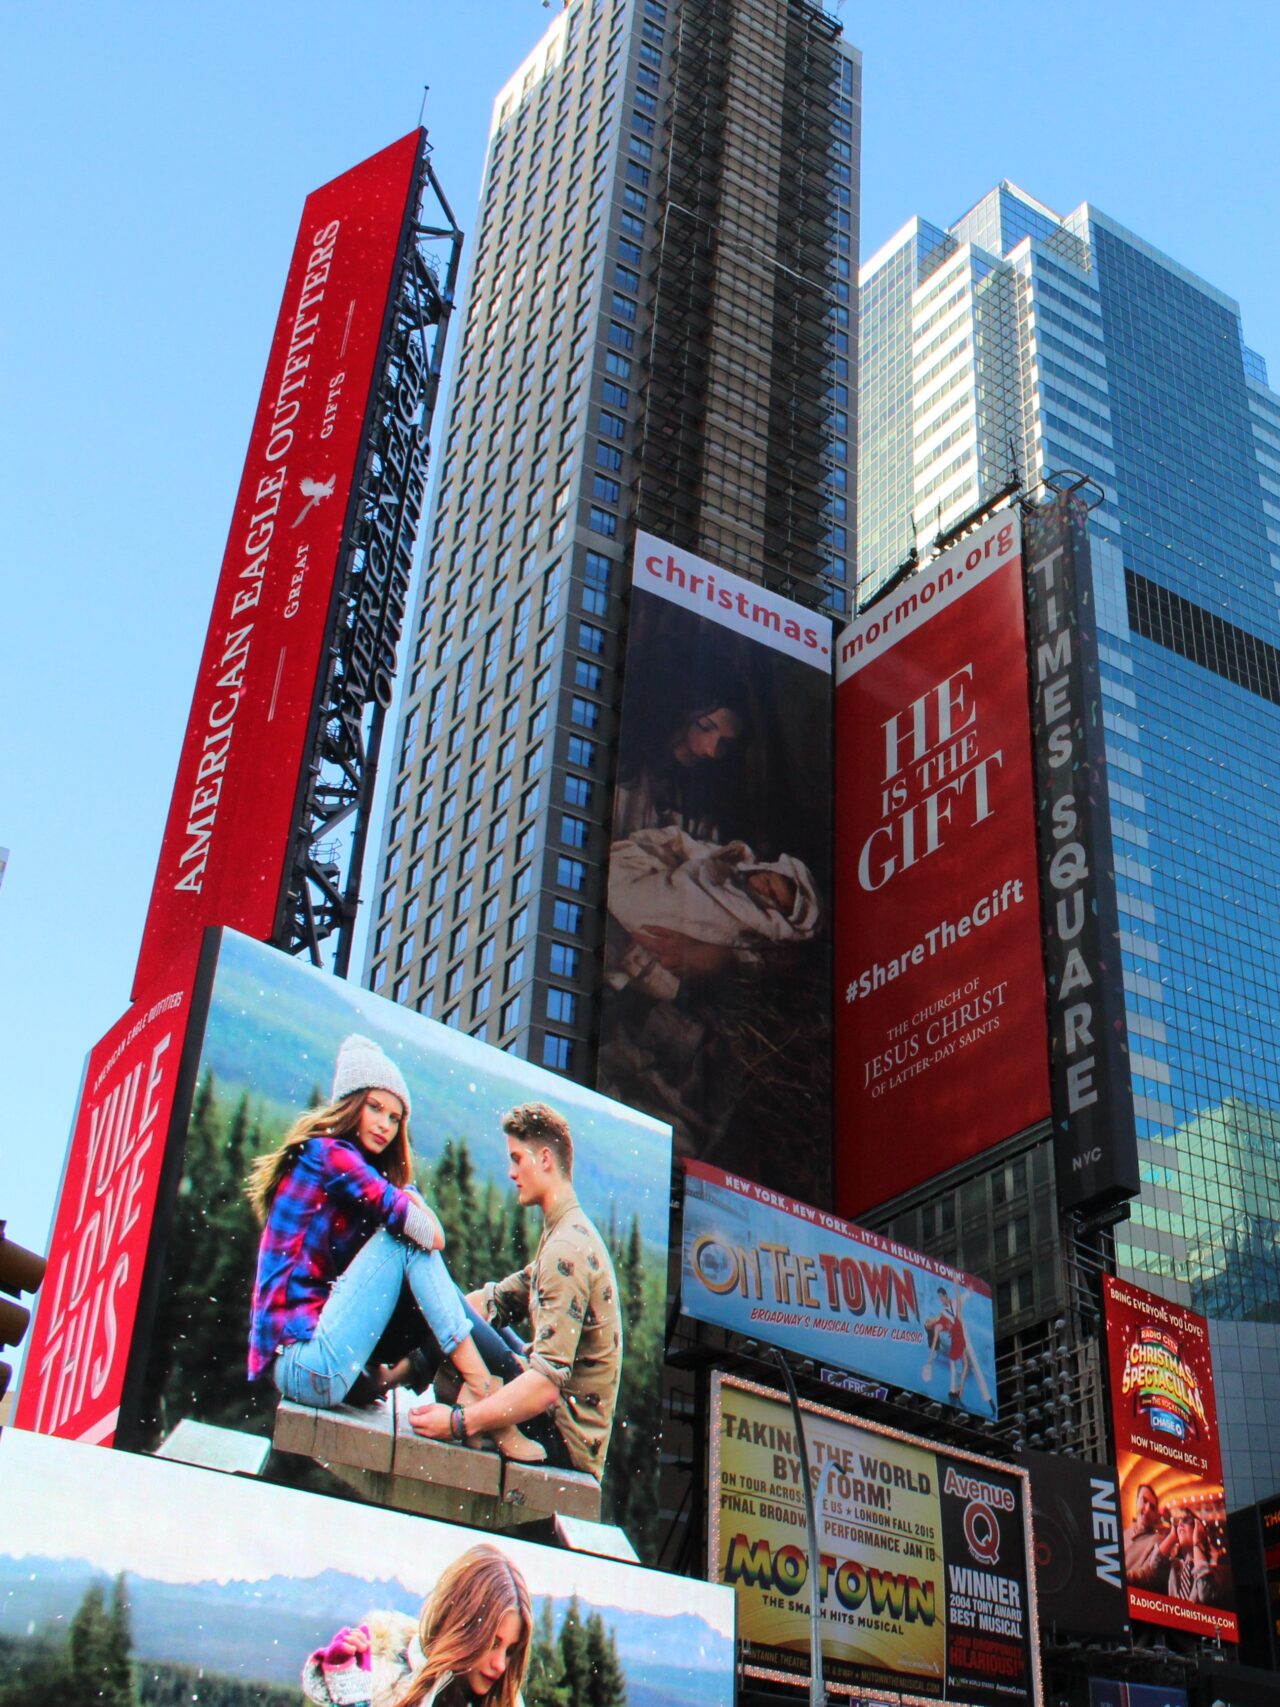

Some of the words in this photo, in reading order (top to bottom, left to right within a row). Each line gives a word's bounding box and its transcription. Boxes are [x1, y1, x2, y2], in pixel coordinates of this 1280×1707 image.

[283, 542, 310, 621] GREAT
[320, 370, 346, 440] GIFTS
[174, 624, 254, 895] AMERICAN
[231, 466, 287, 609] EAGLE
[264, 217, 341, 468] OUTFITTERS
[842, 521, 1014, 664] mormon.org
[645, 552, 829, 655] christmas.
[1031, 545, 1073, 769] TIMES
[881, 662, 976, 785] HE
[881, 778, 908, 819] IS
[916, 729, 979, 792] THE
[858, 749, 1003, 892] GIFT
[846, 878, 1025, 1004] #ShareTheGift
[1049, 794, 1098, 1115] SQUARE
[93, 1037, 128, 1096] AMERICAN
[125, 1016, 147, 1048] EAGLE
[147, 990, 183, 1027] OUTFITTERS
[864, 1033, 920, 1089] JESUS
[926, 981, 1008, 1047] CHRIST
[887, 1019, 909, 1042] THE
[911, 987, 961, 1027] CHURCH
[963, 977, 981, 995] OF
[871, 1082, 887, 1099] OF
[889, 1040, 957, 1090] LATTER-DAY
[959, 1016, 1001, 1048] SAINTS
[1072, 1146, 1102, 1172] NYC
[45, 1130, 153, 1348] LOVE
[724, 1174, 751, 1194] NEW
[753, 1186, 790, 1213] YORK,
[792, 1201, 816, 1221] NEW
[819, 1212, 859, 1240] YORK...
[861, 1229, 879, 1246] IT'S
[881, 1238, 889, 1252] A
[890, 1242, 932, 1271] HELLUVA
[933, 1259, 966, 1285] TOWN!
[691, 1234, 762, 1301] ON
[759, 1240, 821, 1310] THE
[818, 1252, 921, 1325] TOWN
[1110, 1287, 1132, 1306] BRING
[1133, 1298, 1168, 1322] EVERYONE
[1168, 1315, 1184, 1330] YOU
[34, 1252, 129, 1435] THIS
[750, 1307, 811, 1329] BROADWAY'S
[812, 1317, 851, 1335] MUSICAL
[853, 1322, 888, 1338] COMEDY
[890, 1327, 924, 1345] CLASSIC
[1130, 1343, 1196, 1390] CHRISTMAS
[1141, 1329, 1162, 1341] RADIO
[1162, 1334, 1178, 1353] CITY
[1121, 1362, 1208, 1426] SPECTACULAR
[773, 1454, 802, 1484] BY
[809, 1465, 892, 1512] STORM!
[812, 1439, 854, 1474] THE
[859, 1454, 931, 1496] WORLD
[944, 1466, 1015, 1513] Avenue
[1131, 1434, 1148, 1449] NOW
[1149, 1440, 1184, 1460] THROUGH
[1184, 1452, 1200, 1467] DEC.
[1201, 1458, 1208, 1470] 31
[720, 1494, 757, 1516] FINAL
[759, 1500, 807, 1529] BROADW
[824, 1520, 900, 1553] PERFORMANCE
[903, 1541, 923, 1559] JAN
[926, 1547, 936, 1562] 18
[722, 1471, 737, 1487] ON
[740, 1475, 767, 1493] TOUR
[830, 1500, 843, 1515] US
[854, 1510, 890, 1529] LONDON
[892, 1518, 912, 1534] FALL
[915, 1523, 935, 1539] 2015
[963, 1500, 1000, 1566] Q
[1089, 1477, 1122, 1590] NEW
[724, 1532, 936, 1627] MOTOWN
[762, 1595, 784, 1609] THE
[788, 1601, 826, 1620] SMAH
[830, 1612, 854, 1625] HITS
[857, 1617, 904, 1636] MUSICAL
[949, 1564, 1020, 1608] WINNER
[950, 1593, 972, 1610] 2004
[972, 1598, 993, 1616] TONY
[994, 1603, 1022, 1623] AWARD
[950, 1608, 976, 1628] BEST
[979, 1615, 1023, 1639] MUSICAL
